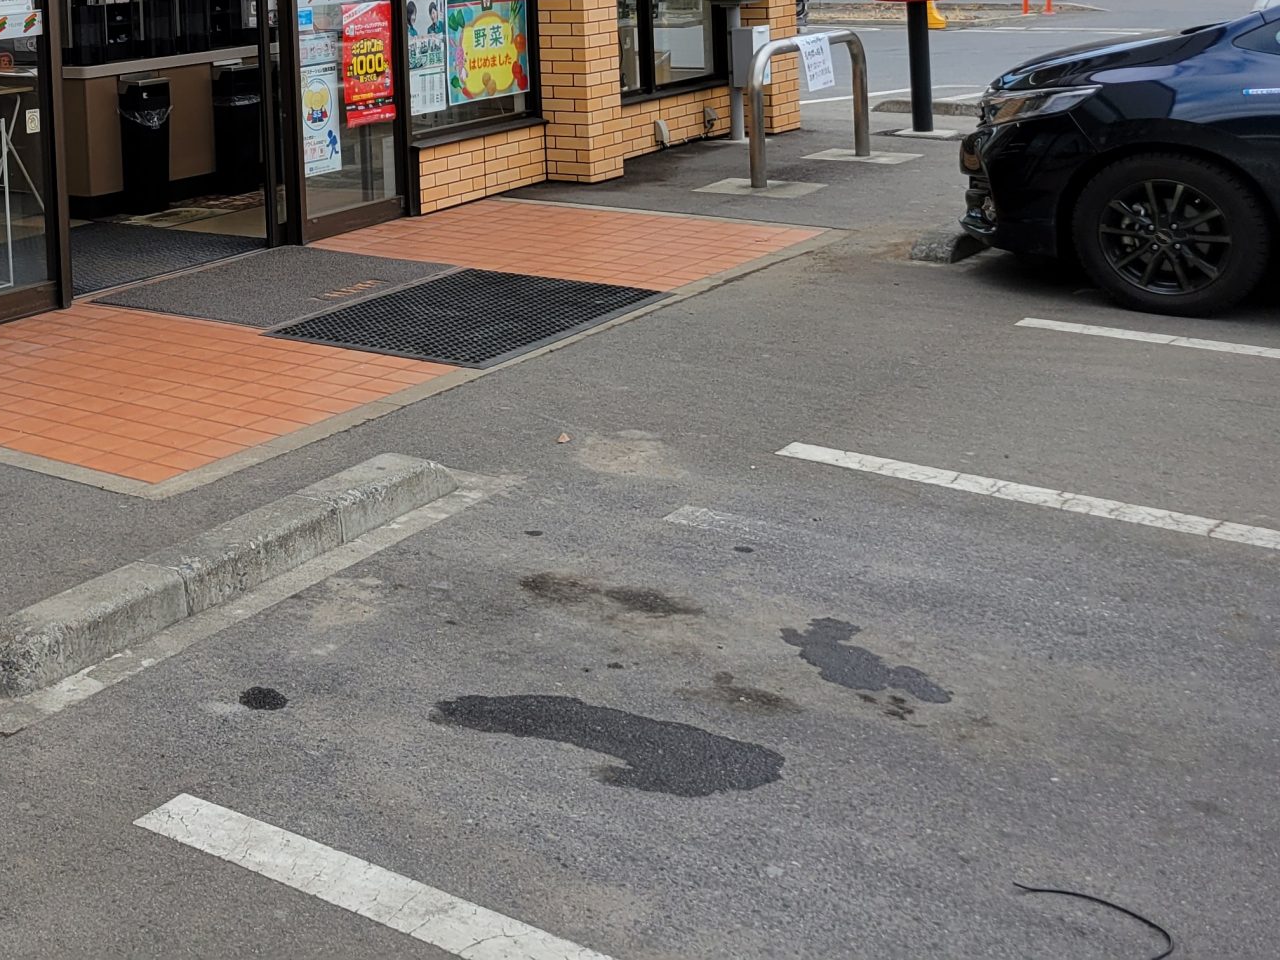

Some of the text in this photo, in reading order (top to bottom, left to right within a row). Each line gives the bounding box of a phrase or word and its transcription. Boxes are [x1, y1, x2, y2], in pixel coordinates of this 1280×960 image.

[473, 25, 503, 49] 野菜
[468, 54, 512, 71] はじめました
